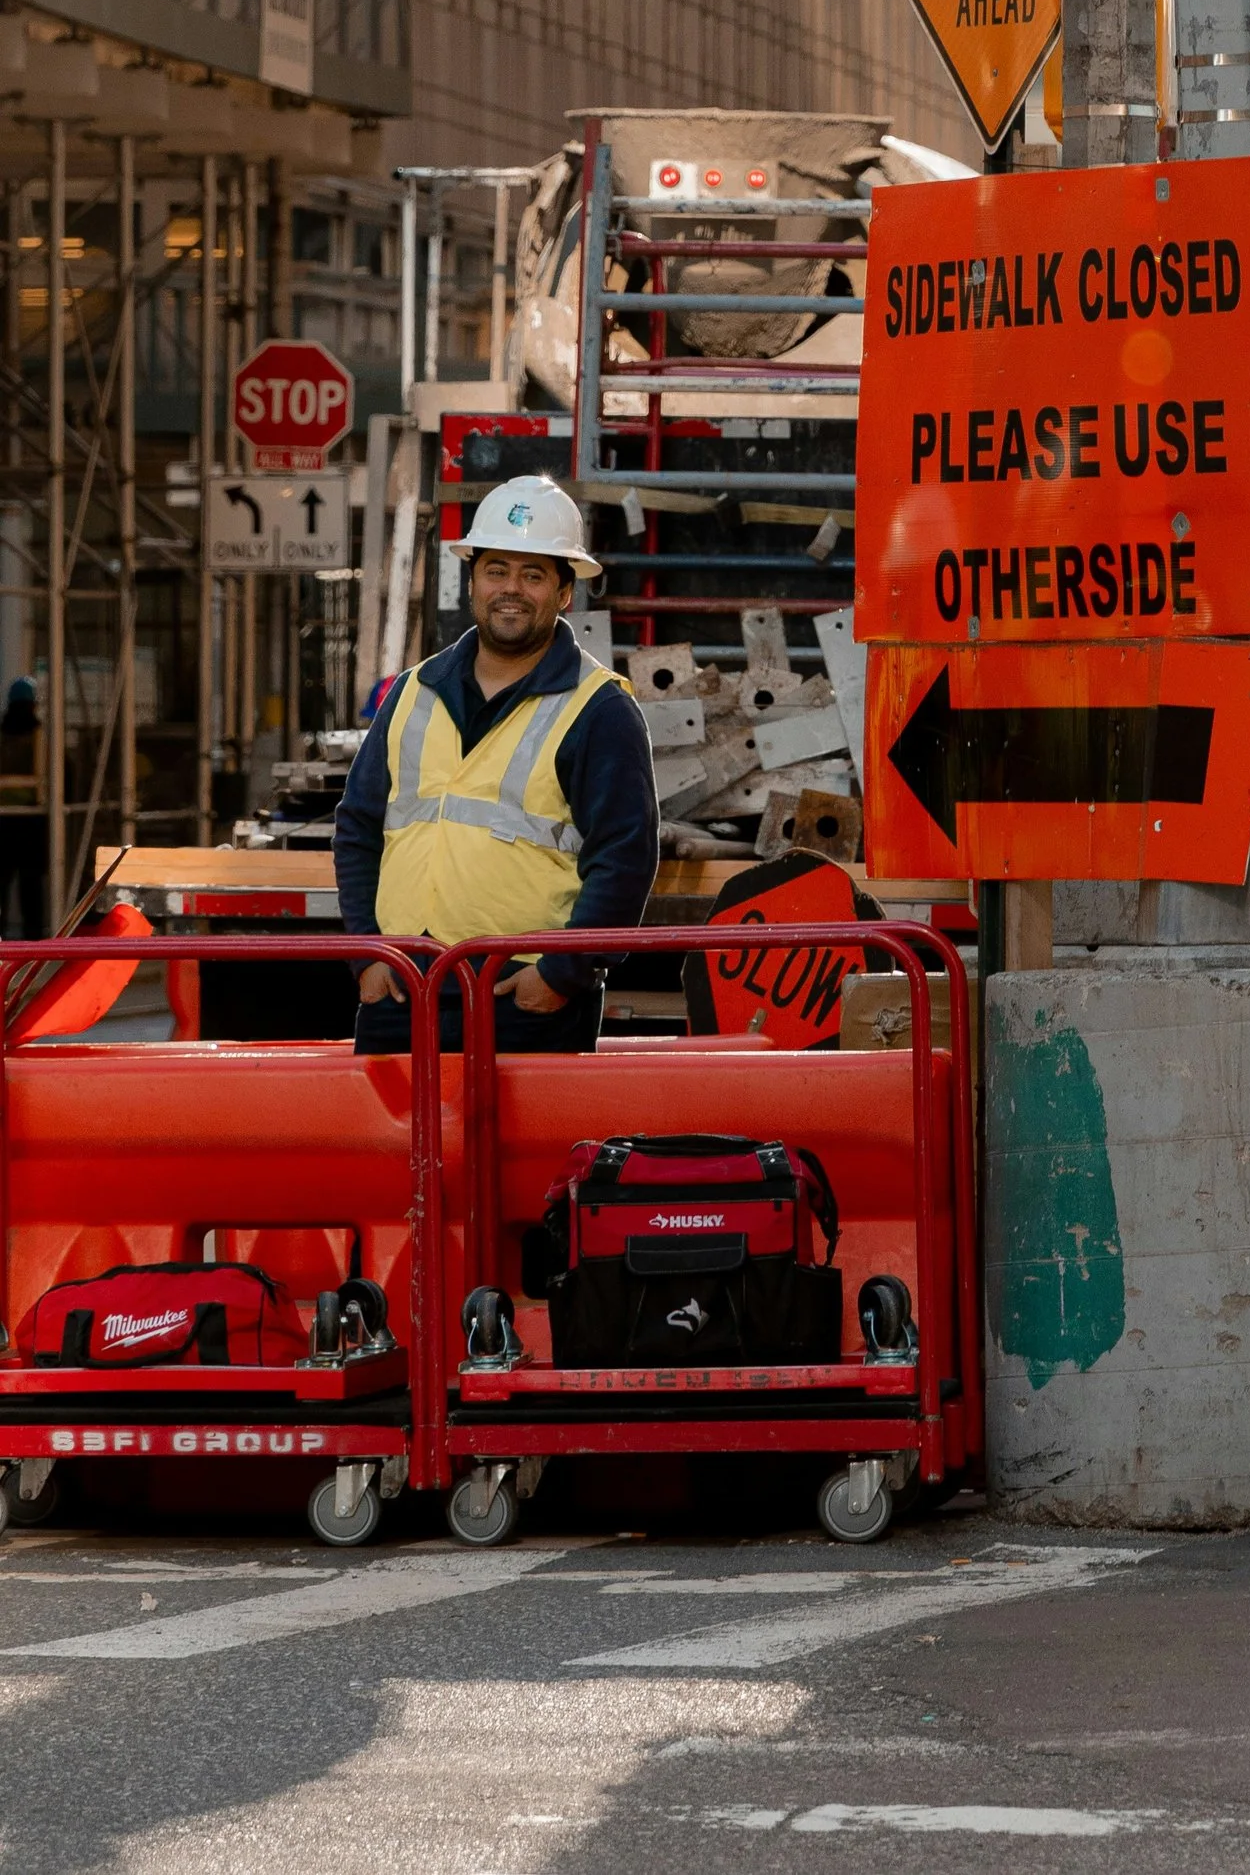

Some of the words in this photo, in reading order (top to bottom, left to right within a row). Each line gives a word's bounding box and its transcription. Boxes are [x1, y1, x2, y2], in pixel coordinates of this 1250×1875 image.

[884, 251, 1063, 338] SIDEWALK
[1077, 238, 1242, 323] CLOSED
[238, 377, 346, 425] STOP
[911, 405, 1101, 485] PLEASE
[1113, 399, 1227, 477] USE
[213, 541, 270, 561] ONLY
[283, 540, 340, 561] ONLY
[934, 540, 1197, 623] OTHERSIDE
[669, 1214, 724, 1228] HUSKY
[102, 1308, 189, 1339] Milwaukee
[173, 1431, 325, 1453] GROUP
